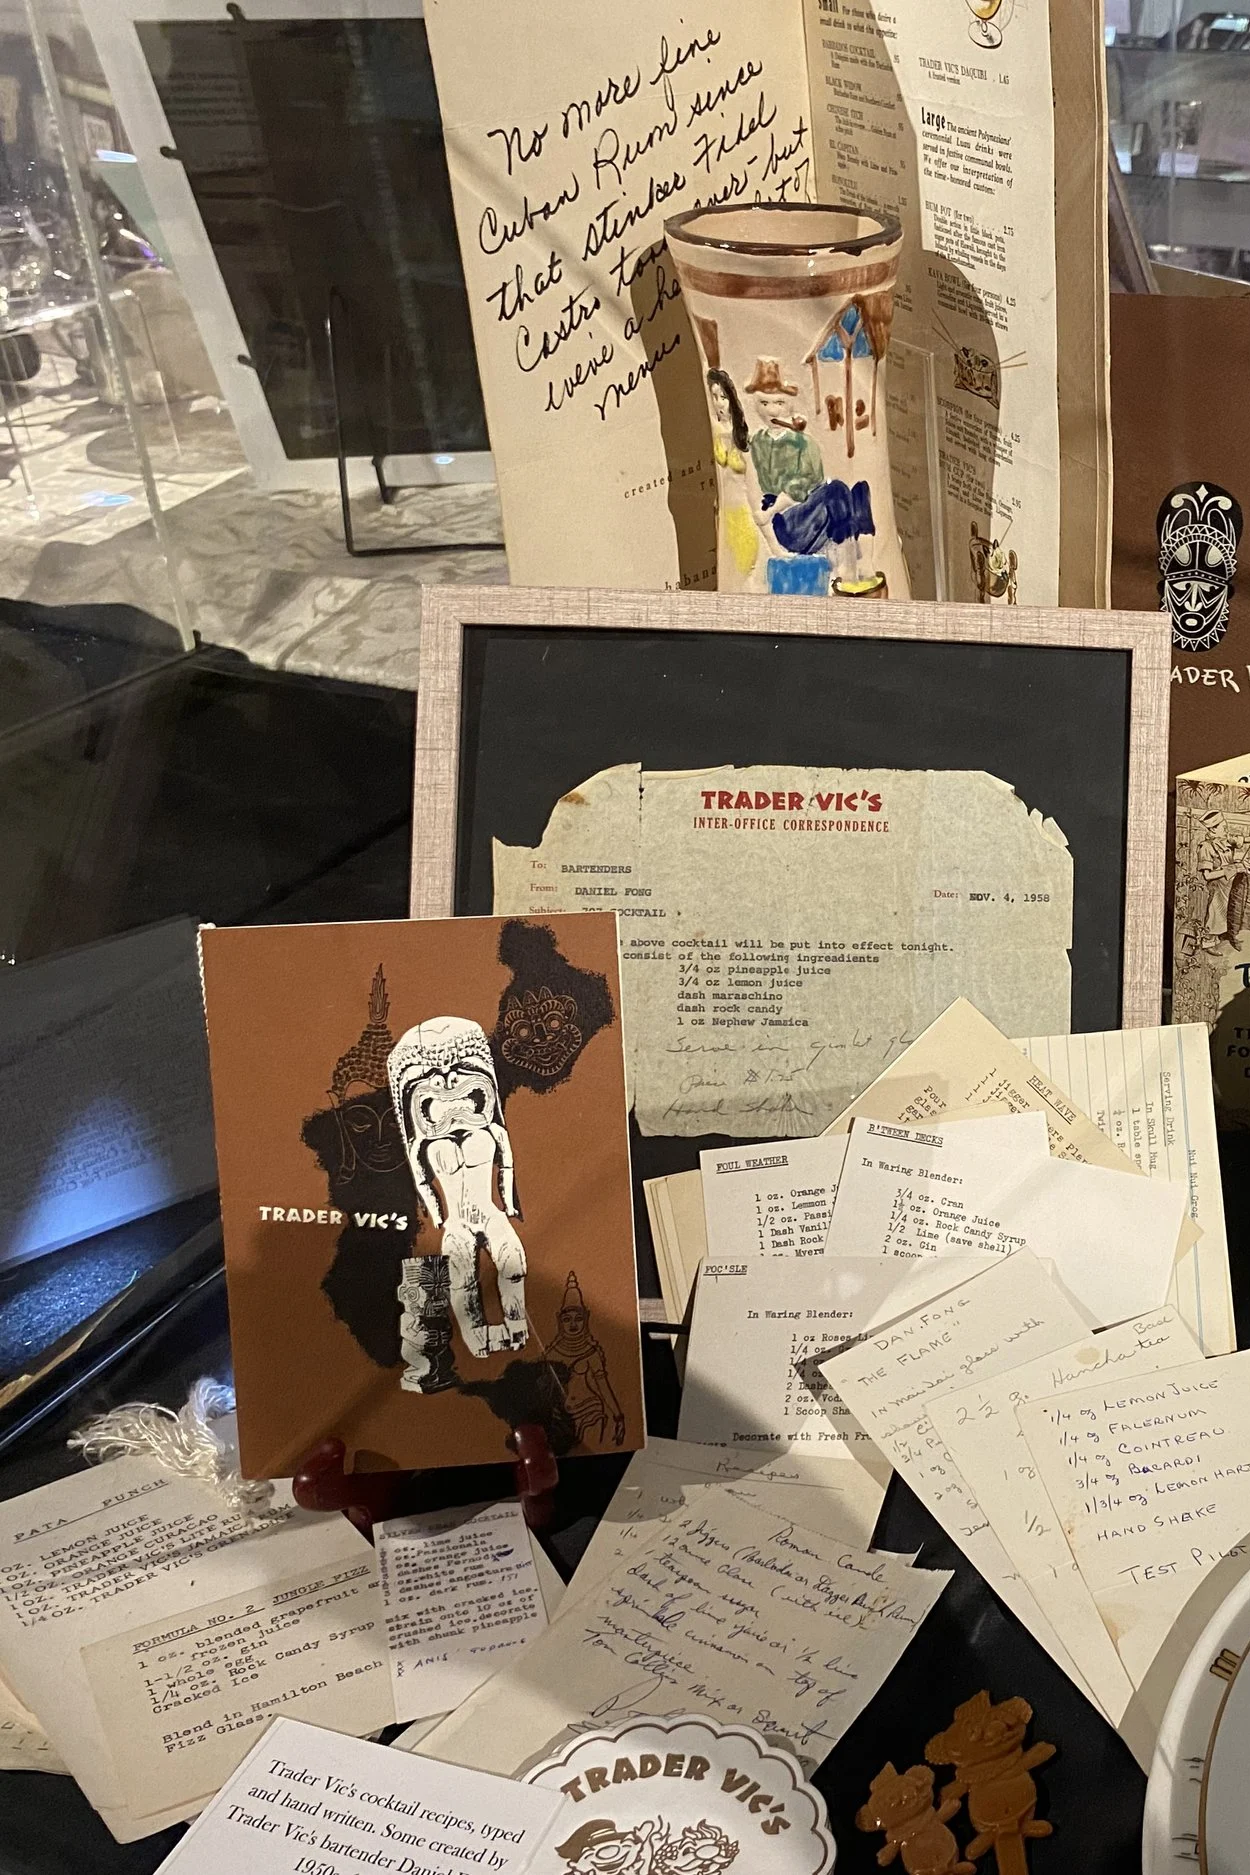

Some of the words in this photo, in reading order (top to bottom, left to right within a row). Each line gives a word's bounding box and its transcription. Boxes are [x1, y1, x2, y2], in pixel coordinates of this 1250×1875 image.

[921, 106, 946, 132] Large
[1170, 666, 1240, 694] ADER
[701, 790, 804, 812] TRADER
[814, 790, 883, 813] VIC'S
[693, 816, 775, 830] INTER-OFFICE
[782, 818, 889, 832] CORRESPONDENCE
[529, 859, 547, 869] To:
[560, 864, 632, 874] BARTENDERS
[574, 886, 618, 896] DANIEL
[623, 887, 652, 896] FONG
[932, 889, 958, 898] Date:
[1023, 892, 1050, 902] 1958
[629, 938, 665, 947] above
[671, 938, 728, 948] cocktail
[734, 938, 763, 948] will
[769, 939, 784, 948] be
[789, 940, 811, 951] put
[817, 939, 845, 950] into
[851, 940, 893, 950] effect
[900, 941, 953, 953] tonight.
[678, 975, 699, 987] 3/4
[704, 978, 720, 986] oz
[727, 977, 762, 987] lemon
[768, 977, 803, 989] juice
[676, 990, 705, 999] dash
[711, 990, 783, 1001] maraschino
[676, 1002, 705, 1012] dash
[712, 1003, 740, 1013] rock
[747, 1004, 783, 1015] candy
[1028, 1075, 1052, 1098] HEAT
[1052, 1097, 1077, 1123] WAVE
[1162, 1071, 1172, 1112] Serving
[1165, 1115, 1175, 1147] Drink
[716, 1162, 741, 1172] FOUL
[746, 1156, 788, 1168] WEATHER
[861, 1158, 873, 1168] In
[879, 1161, 913, 1176] Waring
[917, 1169, 963, 1185] Blender:
[259, 1206, 342, 1225] TRADER
[354, 1212, 409, 1231] VIC'S
[14, 1518, 68, 1540] PATA
[102, 1478, 166, 1507] PUNCH
[273, 1579, 325, 1603] JUNGLE
[333, 1565, 370, 1583] FIZZ
[133, 1625, 198, 1651] FORMULA
[208, 1614, 235, 1626] NO.
[245, 1604, 255, 1614] 2
[268, 1760, 320, 1786] Trader
[324, 1775, 357, 1797] Vic's
[359, 1792, 421, 1816] cocktail
[418, 1808, 475, 1834] recipes,
[480, 1823, 525, 1844] typed
[560, 1753, 710, 1803] TRADER
[720, 1767, 791, 1835] VIC'S
[247, 1786, 281, 1803] and
[279, 1791, 323, 1816] hand
[322, 1808, 375, 1833] written.
[380, 1823, 426, 1847] Some
[428, 1841, 488, 1863] created
[487, 1850, 508, 1870] by
